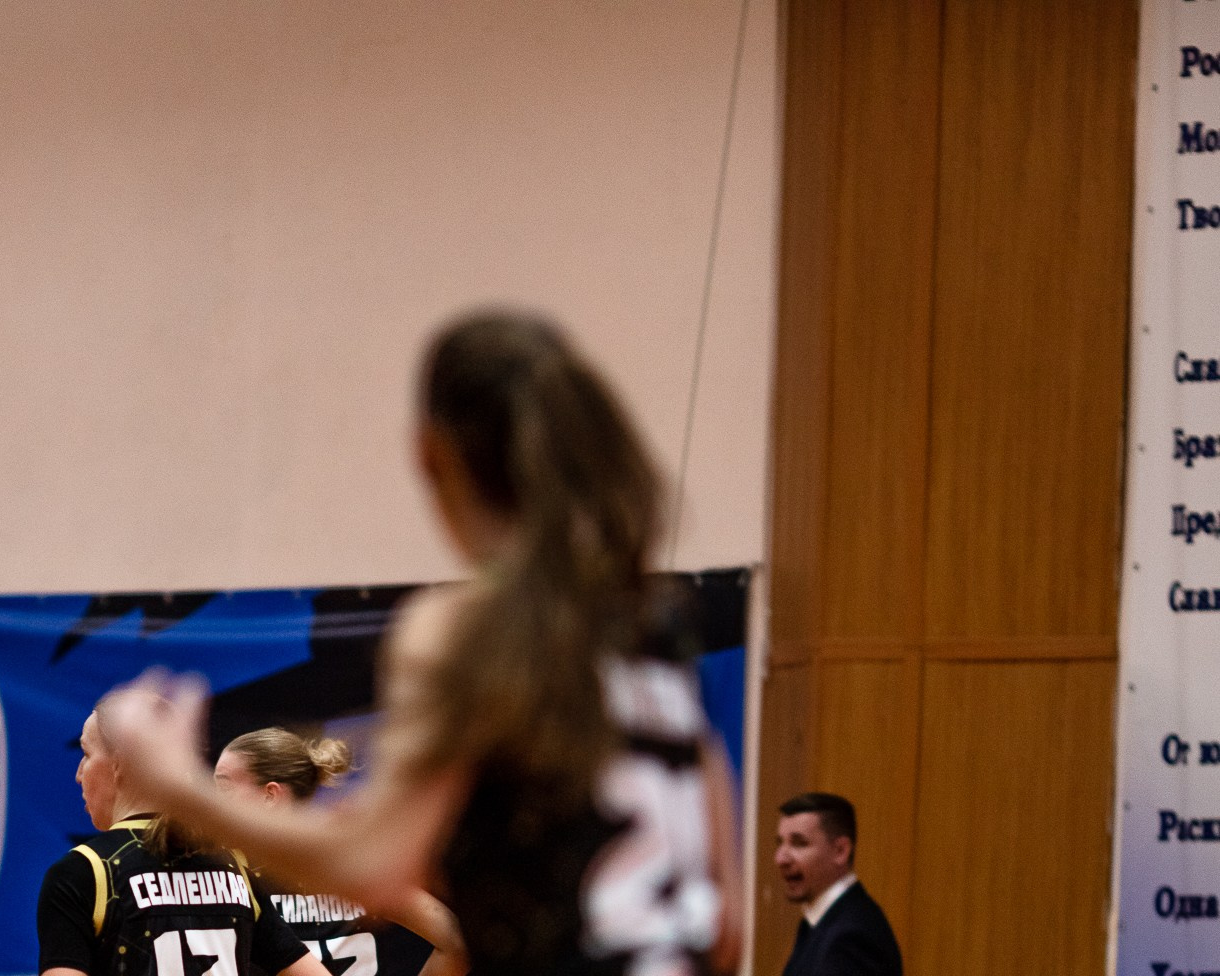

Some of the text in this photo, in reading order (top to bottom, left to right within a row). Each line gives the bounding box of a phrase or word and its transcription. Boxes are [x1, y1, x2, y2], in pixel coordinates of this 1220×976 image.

[1172, 427, 1220, 468] Бра
[1171, 504, 1220, 544] Пре
[1161, 734, 1190, 766] От
[129, 871, 252, 909] СЕДЛЕЦКАЯ
[1154, 886, 1219, 923] Одна
